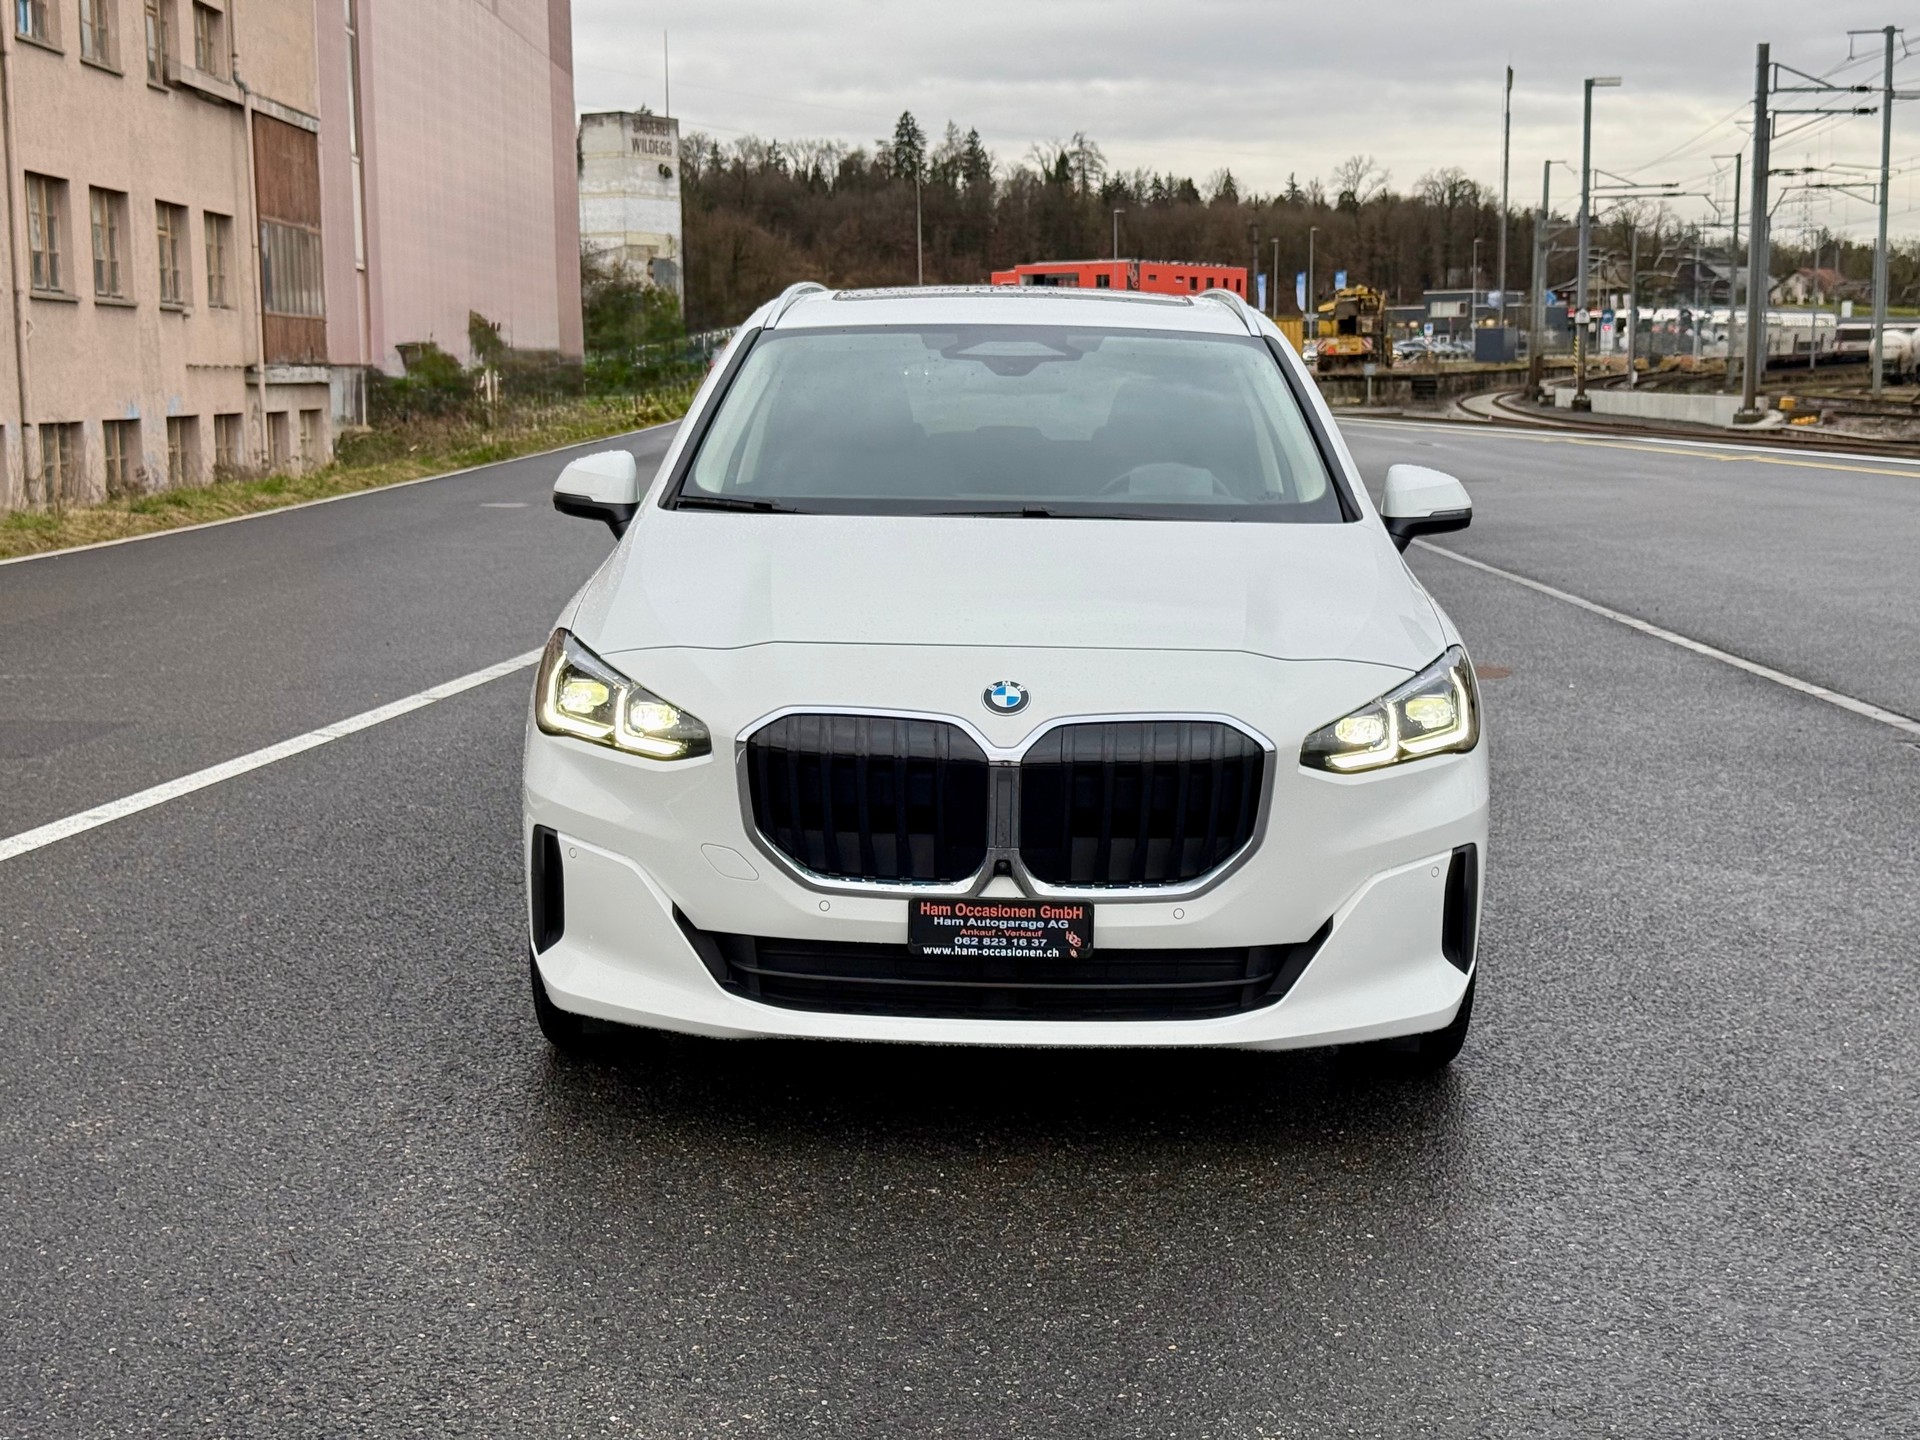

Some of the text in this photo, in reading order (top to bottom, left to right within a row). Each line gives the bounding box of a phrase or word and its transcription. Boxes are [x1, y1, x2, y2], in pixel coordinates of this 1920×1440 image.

[631, 138, 672, 156] WILDEGG
[920, 902, 1083, 919] Ham Occasionen GmbH
[934, 917, 1069, 929] Ham Autogarage AG
[959, 928, 995, 936] Ankauf
[954, 937, 1047, 947] 062 823 16 37
[923, 946, 1059, 958] www.ham-occasionen.ch
